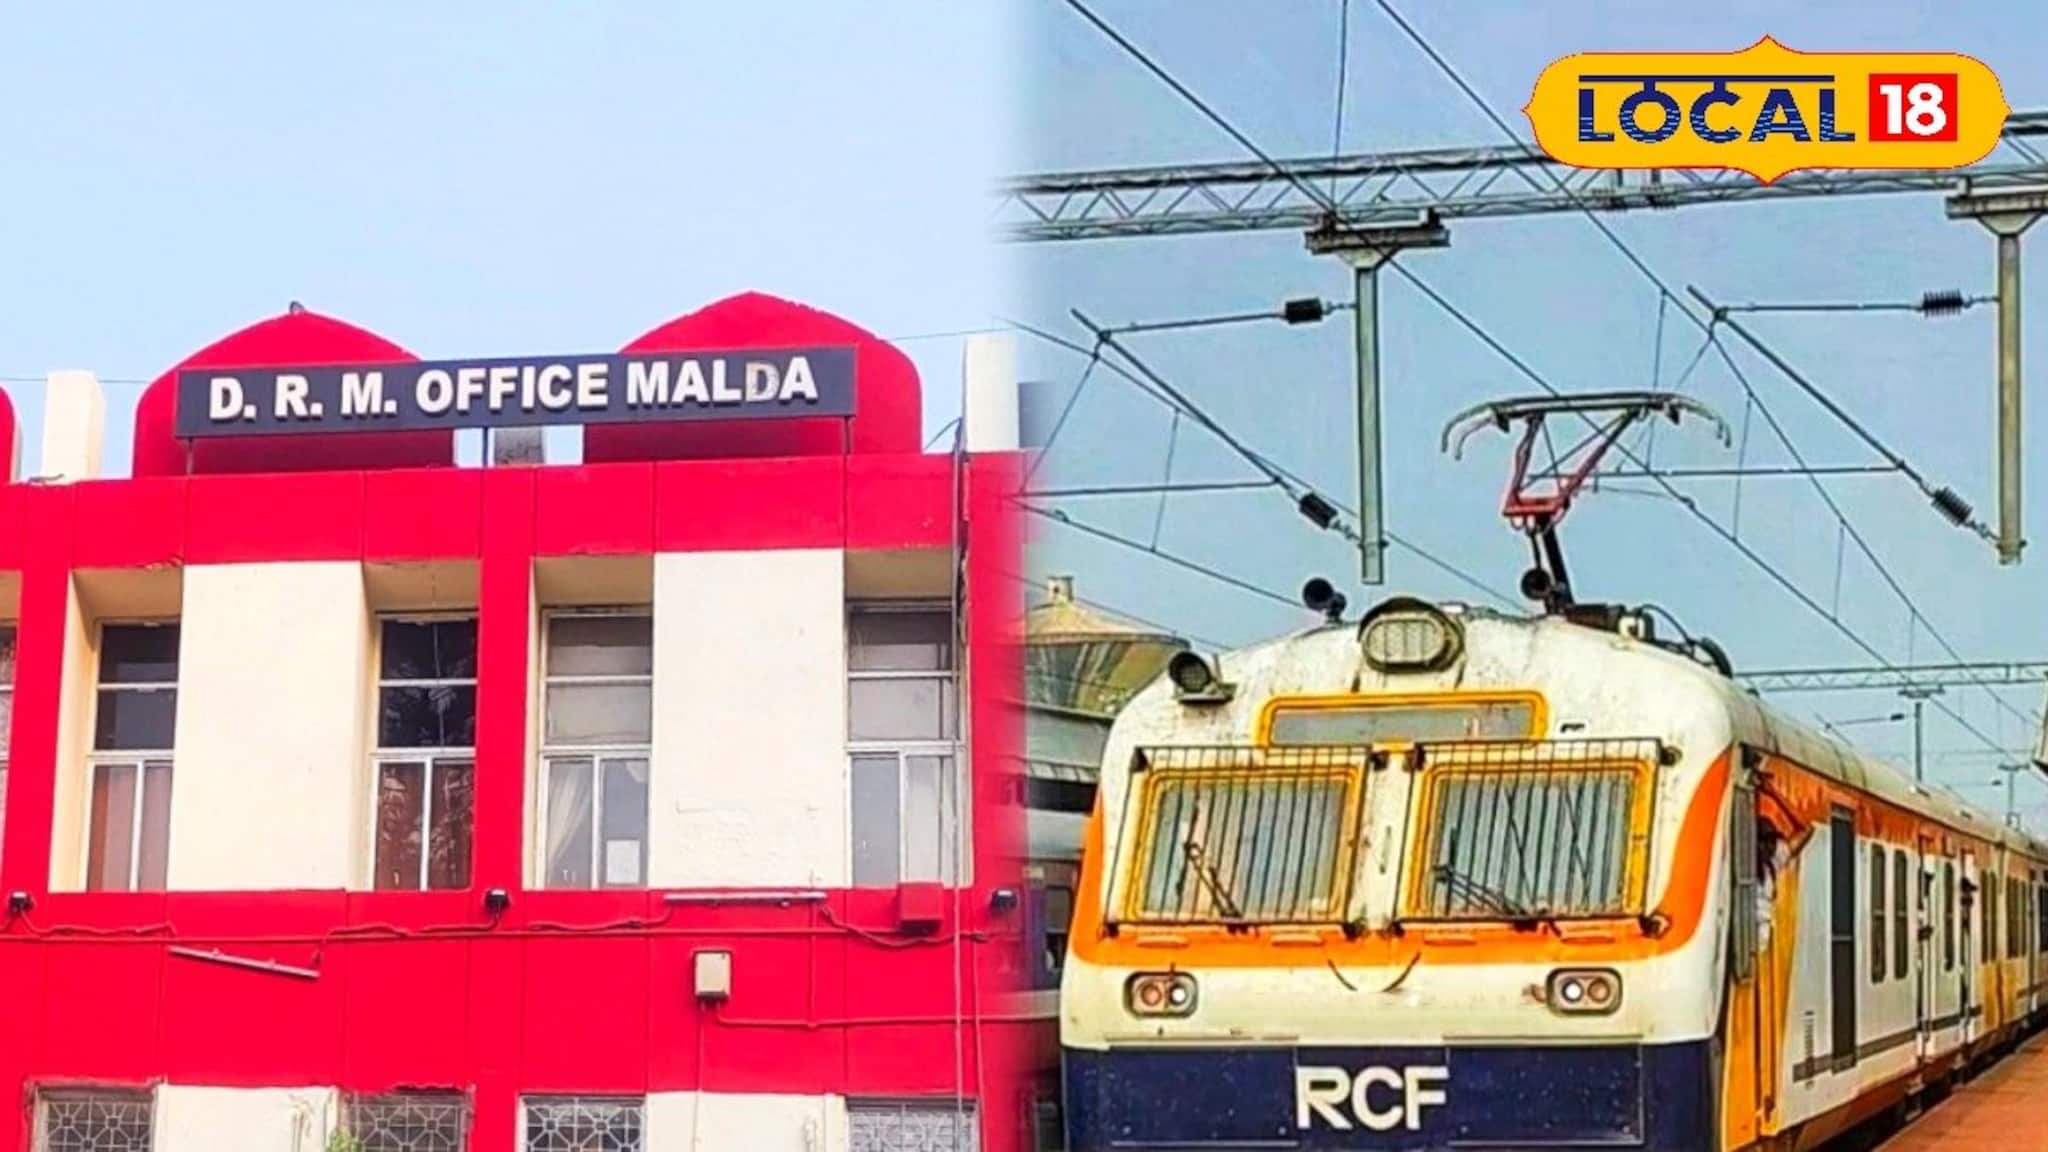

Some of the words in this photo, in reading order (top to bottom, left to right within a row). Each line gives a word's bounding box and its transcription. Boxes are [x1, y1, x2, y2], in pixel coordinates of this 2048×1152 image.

[209, 376, 257, 420] D.
[274, 373, 324, 418] R.
[340, 371, 398, 415] M.
[415, 362, 610, 413] OFFICE
[626, 356, 820, 406] MALDA
[1295, 1065, 1450, 1130] RCF
